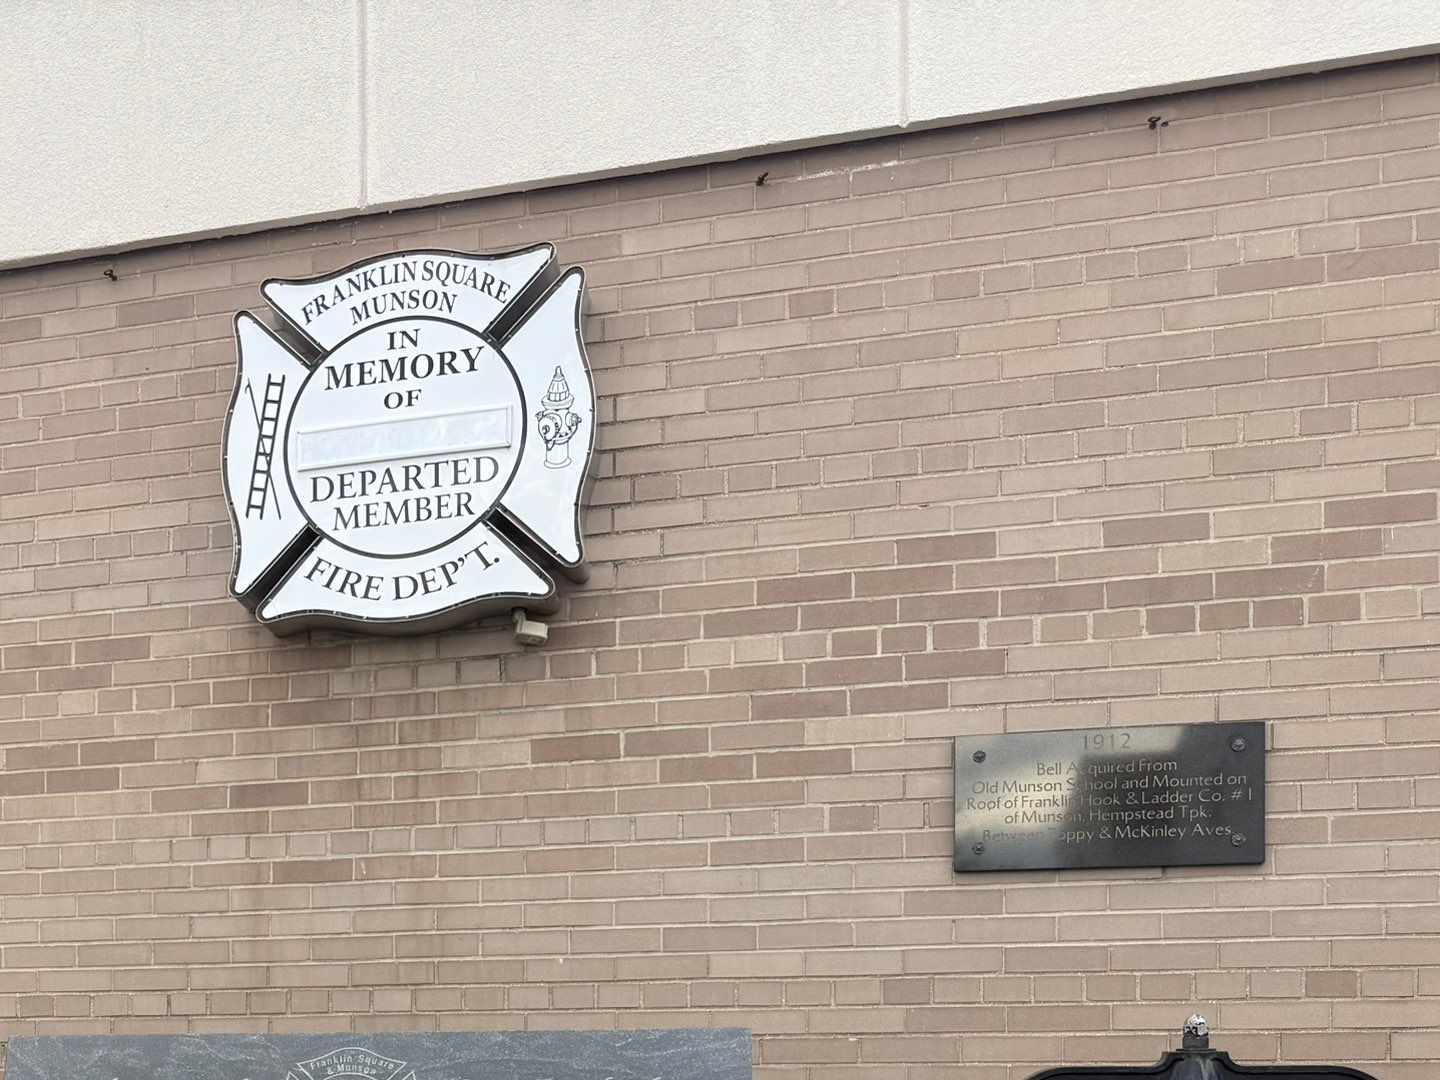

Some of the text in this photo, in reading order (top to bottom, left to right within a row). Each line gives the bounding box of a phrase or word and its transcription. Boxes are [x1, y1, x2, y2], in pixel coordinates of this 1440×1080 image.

[300, 260, 512, 325] FRANKLIN SQUARE
[350, 289, 458, 325] MUNSON
[387, 328, 421, 351] IN
[324, 345, 485, 391] MEMORY
[383, 389, 422, 410] OF
[310, 456, 500, 504] DEPARTED
[332, 491, 476, 531] MEMBER
[304, 556, 384, 601] FIRE
[1037, 762, 1062, 776] Bell
[1139, 759, 1178, 773] From
[971, 780, 999, 795] Old
[1002, 780, 1062, 794] Munson
[1122, 775, 1149, 790] and
[1152, 773, 1223, 788] Mounted
[1227, 774, 1247, 785] on
[967, 797, 1002, 812] Roof
[1004, 796, 1019, 809] of
[1021, 794, 1076, 809] Franklin
[1080, 793, 1121, 807] Hook
[1126, 791, 1139, 805] &
[1141, 790, 1194, 805] Ladder
[1198, 788, 1226, 802] Co.
[1004, 804, 1212, 824] of Munson, Hempstead Tpk.
[982, 829, 1043, 842] Between
[1099, 825, 1112, 840] &
[1114, 824, 1187, 841] McKinley
[309, 1054, 395, 1070] Franklin Square
[337, 1064, 377, 1075] Munson
